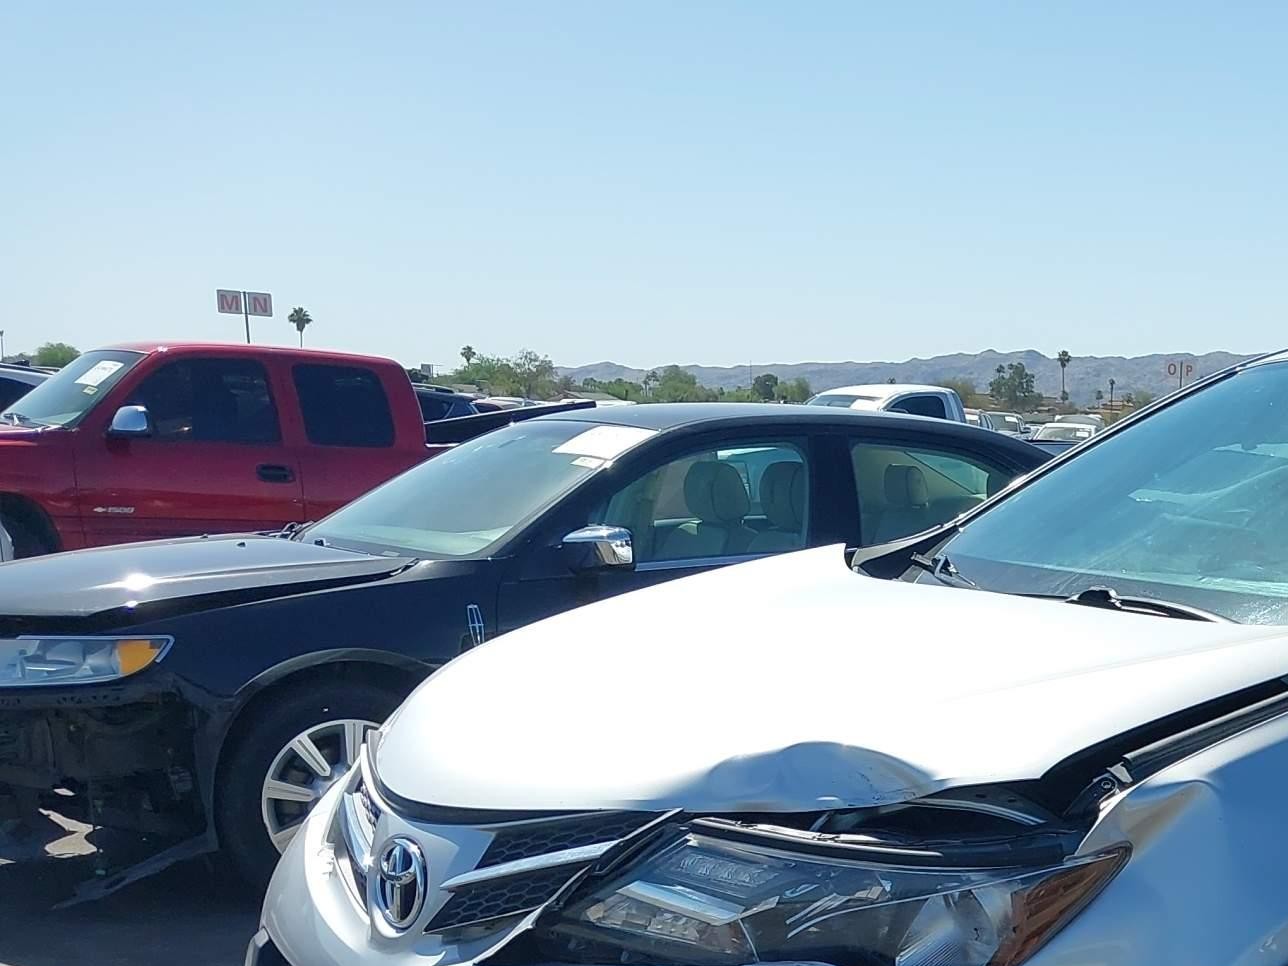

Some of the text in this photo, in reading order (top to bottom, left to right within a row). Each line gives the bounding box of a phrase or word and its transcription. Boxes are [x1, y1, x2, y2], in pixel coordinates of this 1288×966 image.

[221, 294, 268, 314] M N
[1185, 364, 1193, 377] P
